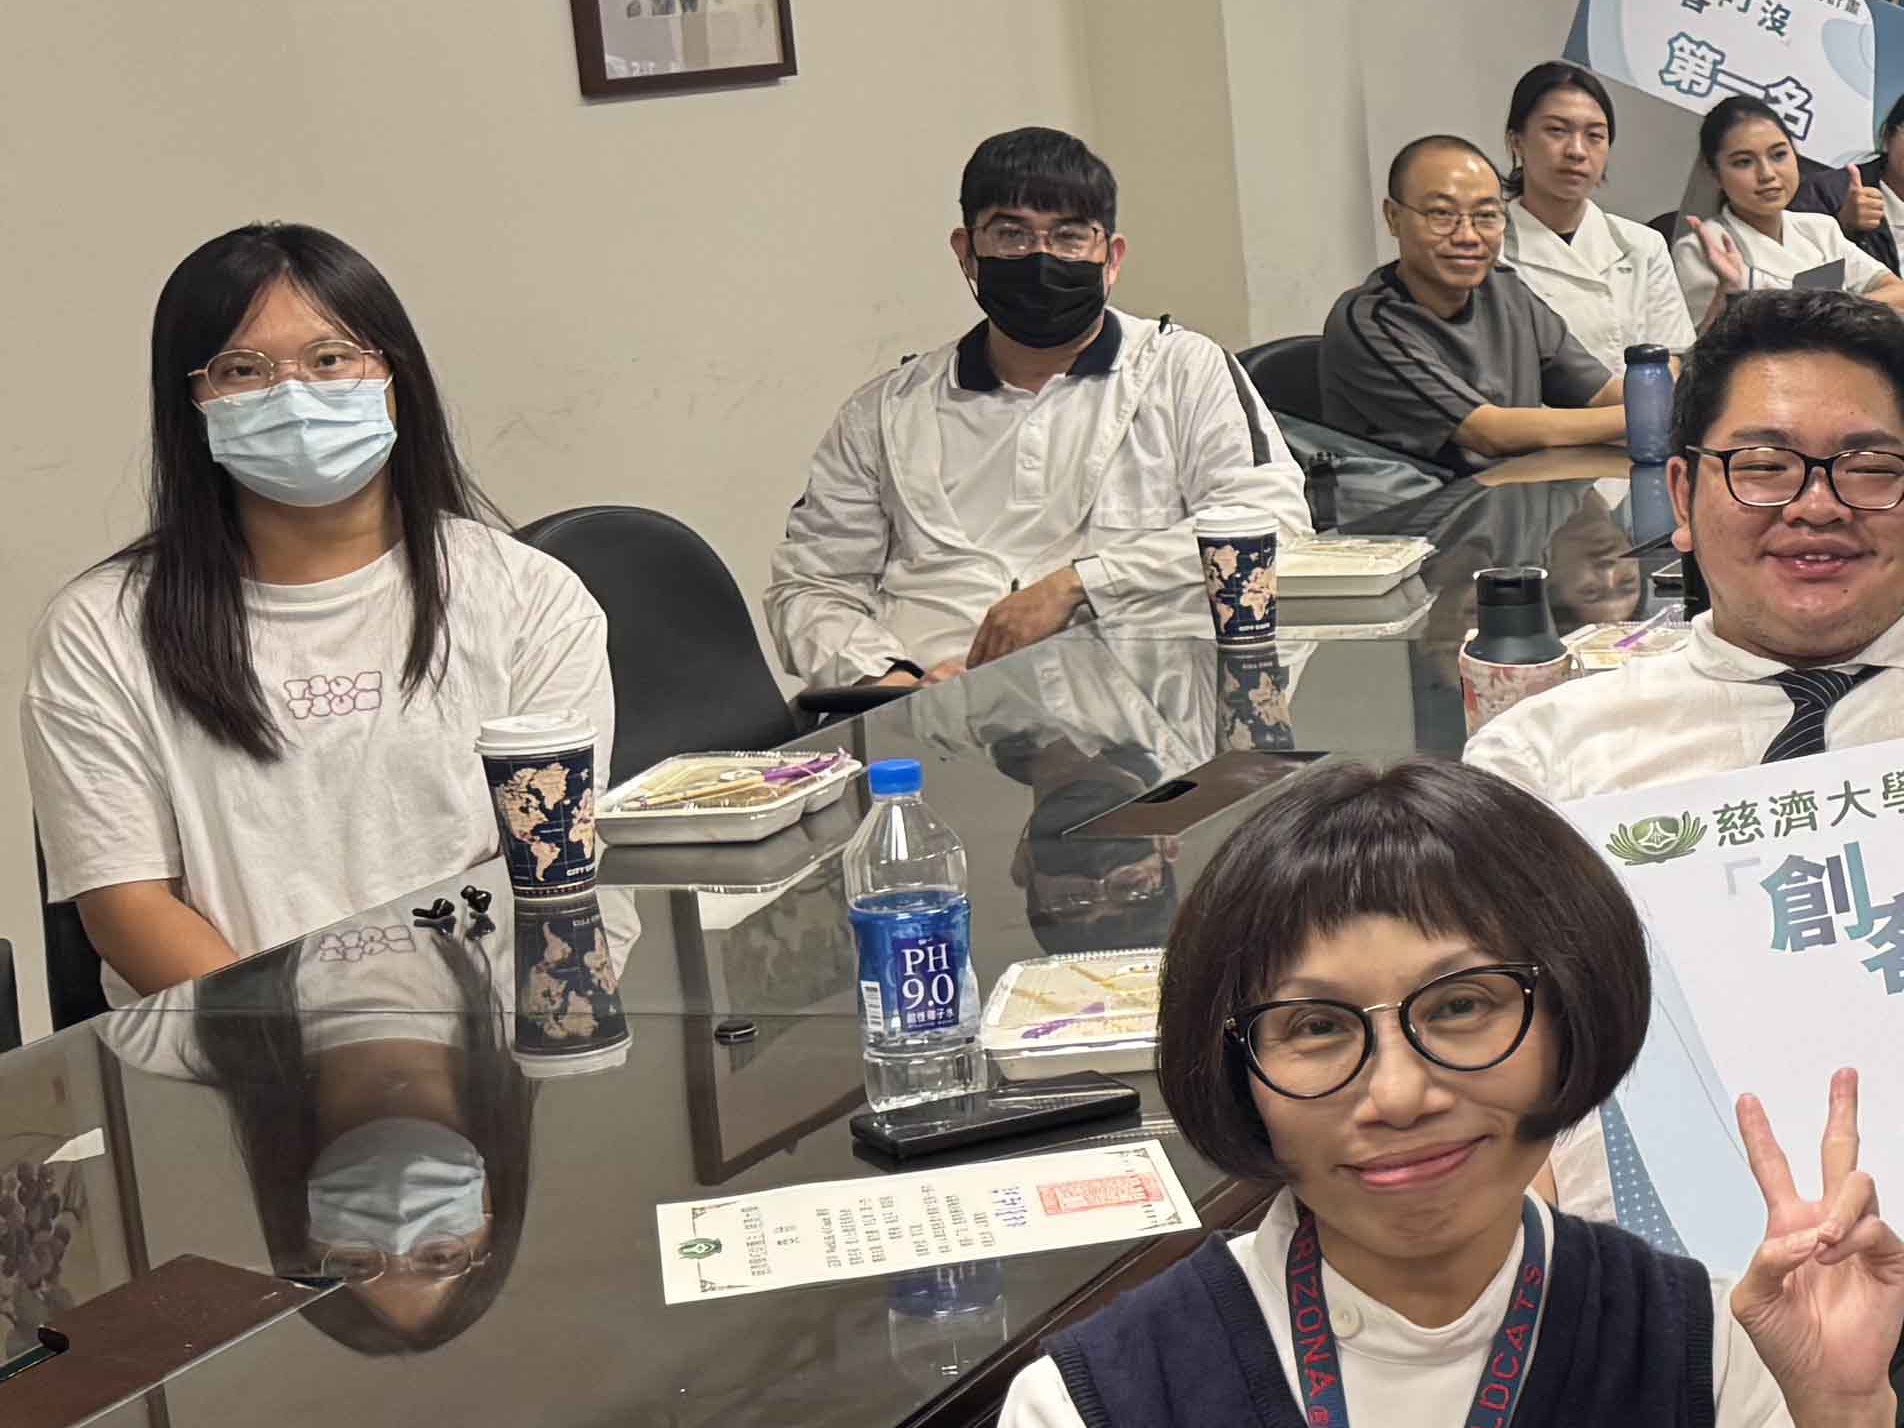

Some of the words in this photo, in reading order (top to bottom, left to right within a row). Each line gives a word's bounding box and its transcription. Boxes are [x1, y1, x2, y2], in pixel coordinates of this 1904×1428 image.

[1658, 30, 1814, 142] 第一名
[901, 943, 951, 976] PH
[902, 973, 955, 1010] 9.0
